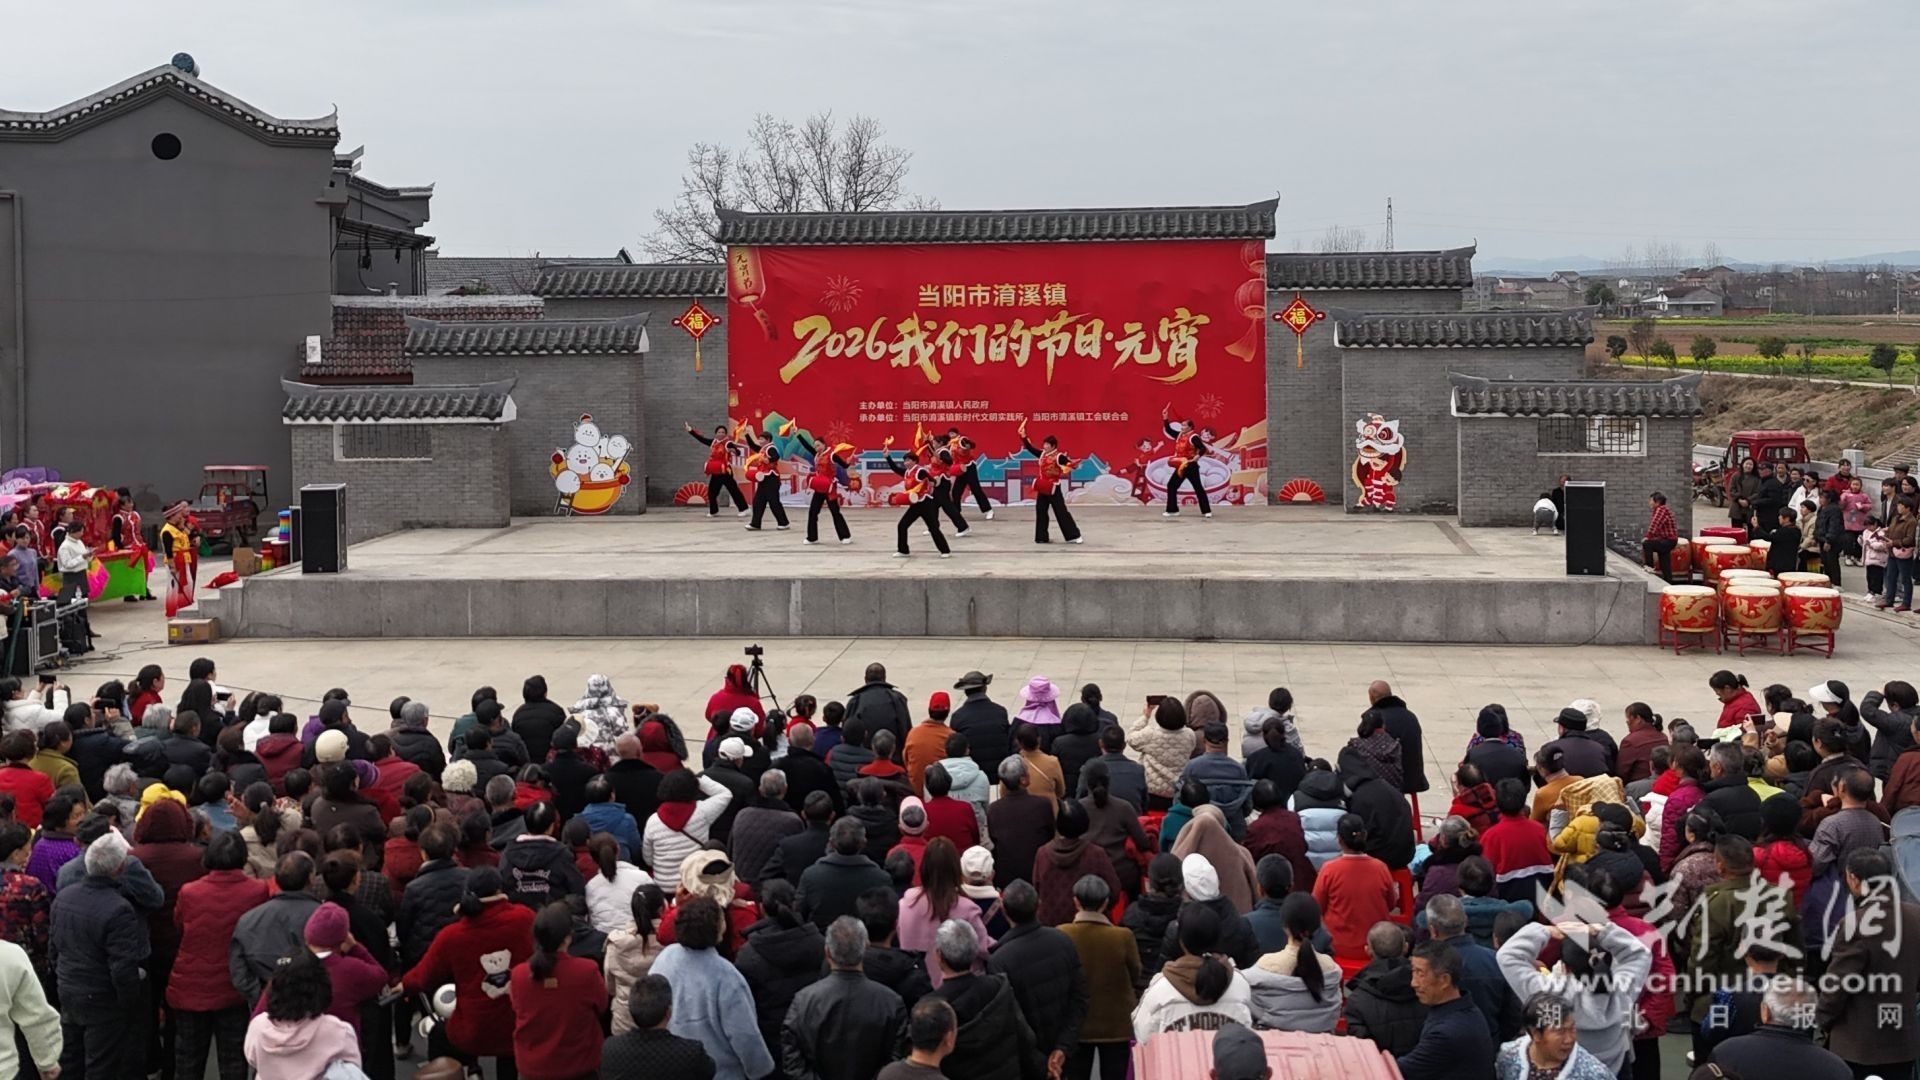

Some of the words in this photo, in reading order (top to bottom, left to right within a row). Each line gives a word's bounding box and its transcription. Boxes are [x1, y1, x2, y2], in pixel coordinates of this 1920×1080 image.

[918, 283, 1067, 307] 当阳市淯溪镇
[688, 313, 704, 329] 福
[1290, 308, 1307, 324] 福
